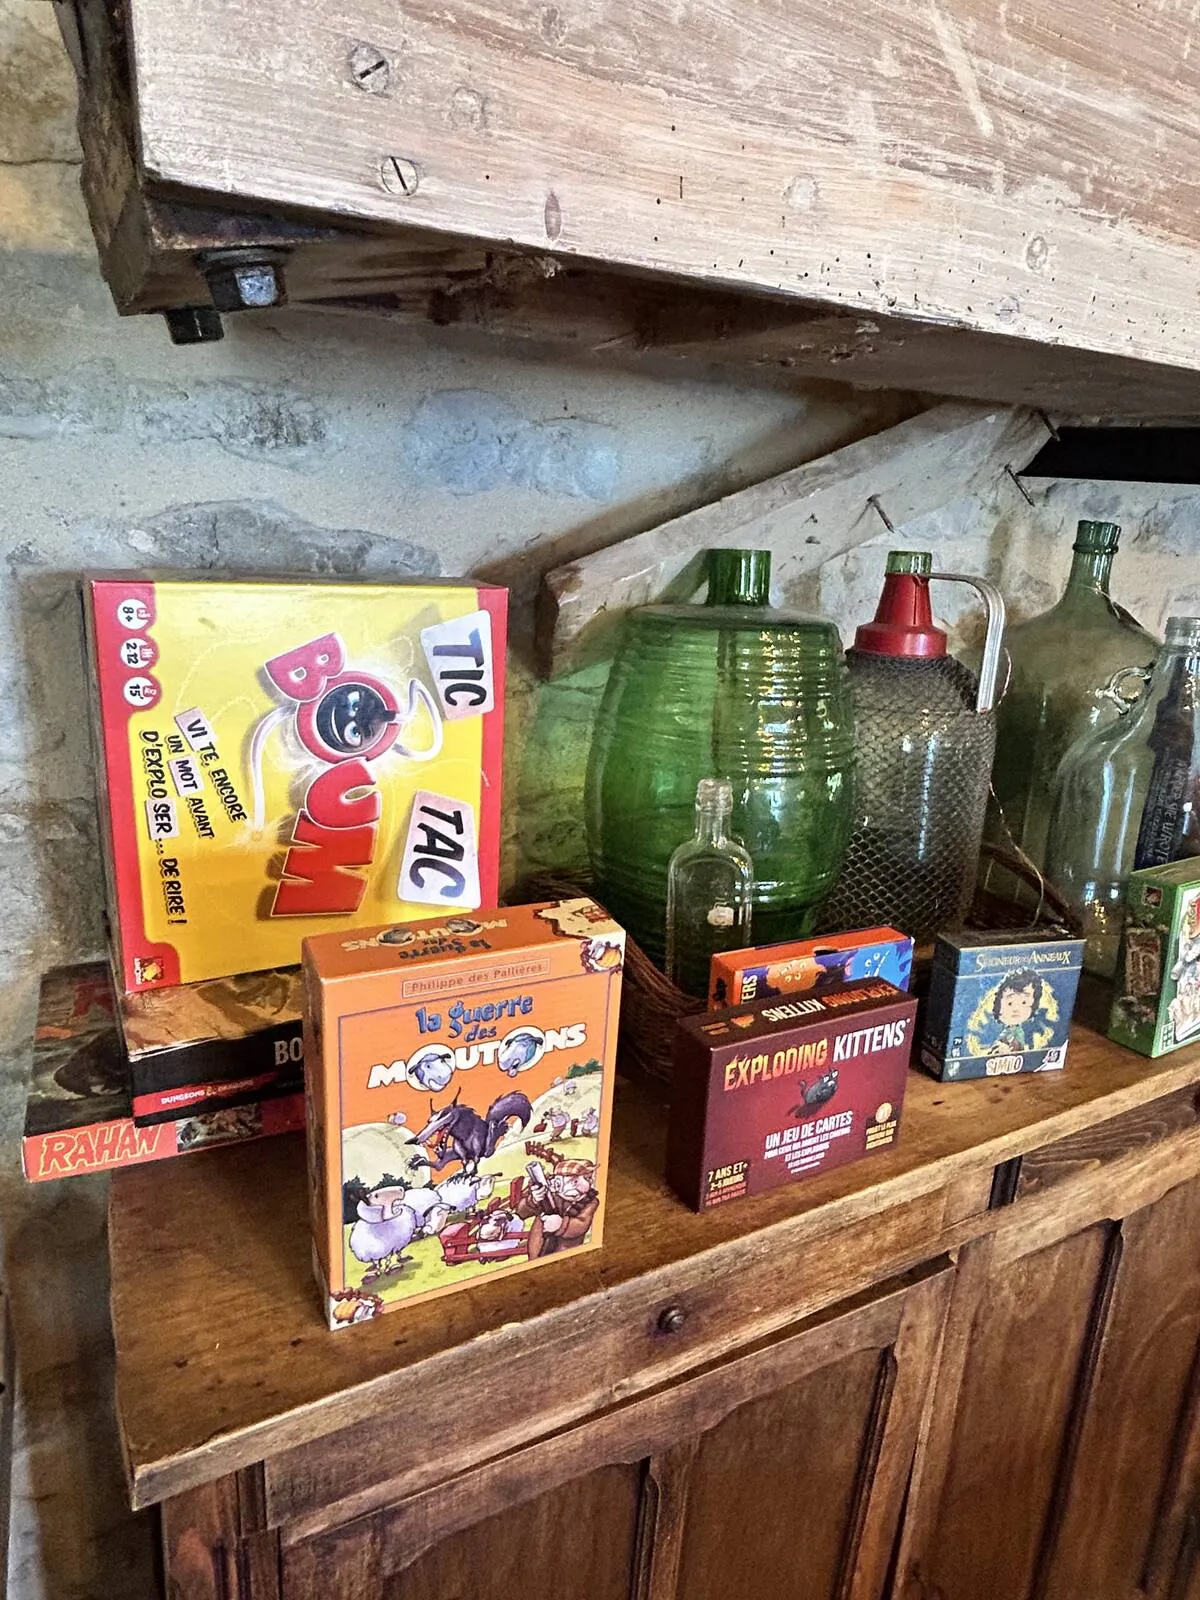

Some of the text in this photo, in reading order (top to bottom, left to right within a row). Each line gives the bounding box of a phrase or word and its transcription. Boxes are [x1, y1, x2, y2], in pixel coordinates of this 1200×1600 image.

[122, 605, 135, 623] 8+
[432, 627, 488, 708] TIC
[167, 734, 216, 840] UN MOT AVANT
[211, 769, 248, 824] ENCORE
[263, 632, 401, 918] BOUM
[409, 803, 465, 898] TAC
[411, 977, 464, 994] Philippe
[468, 972, 490, 984] des
[416, 994, 534, 1038] la guerre
[761, 998, 827, 1022] KITTENS
[463, 1025, 498, 1043] des
[366, 1021, 588, 1093] MOUTONS
[724, 1038, 829, 1092] EXPLODING
[987, 1056, 1023, 1074] SIMILO
[160, 1089, 205, 1105] DUNGEONS
[38, 1122, 163, 1176] RAHAN
[765, 1132, 781, 1150] UN
[781, 1127, 801, 1145] JEU
[801, 1122, 815, 1139] DE
[815, 1110, 853, 1136] CARTES
[708, 1171, 714, 1182] 7
[714, 1166, 732, 1180] ANS
